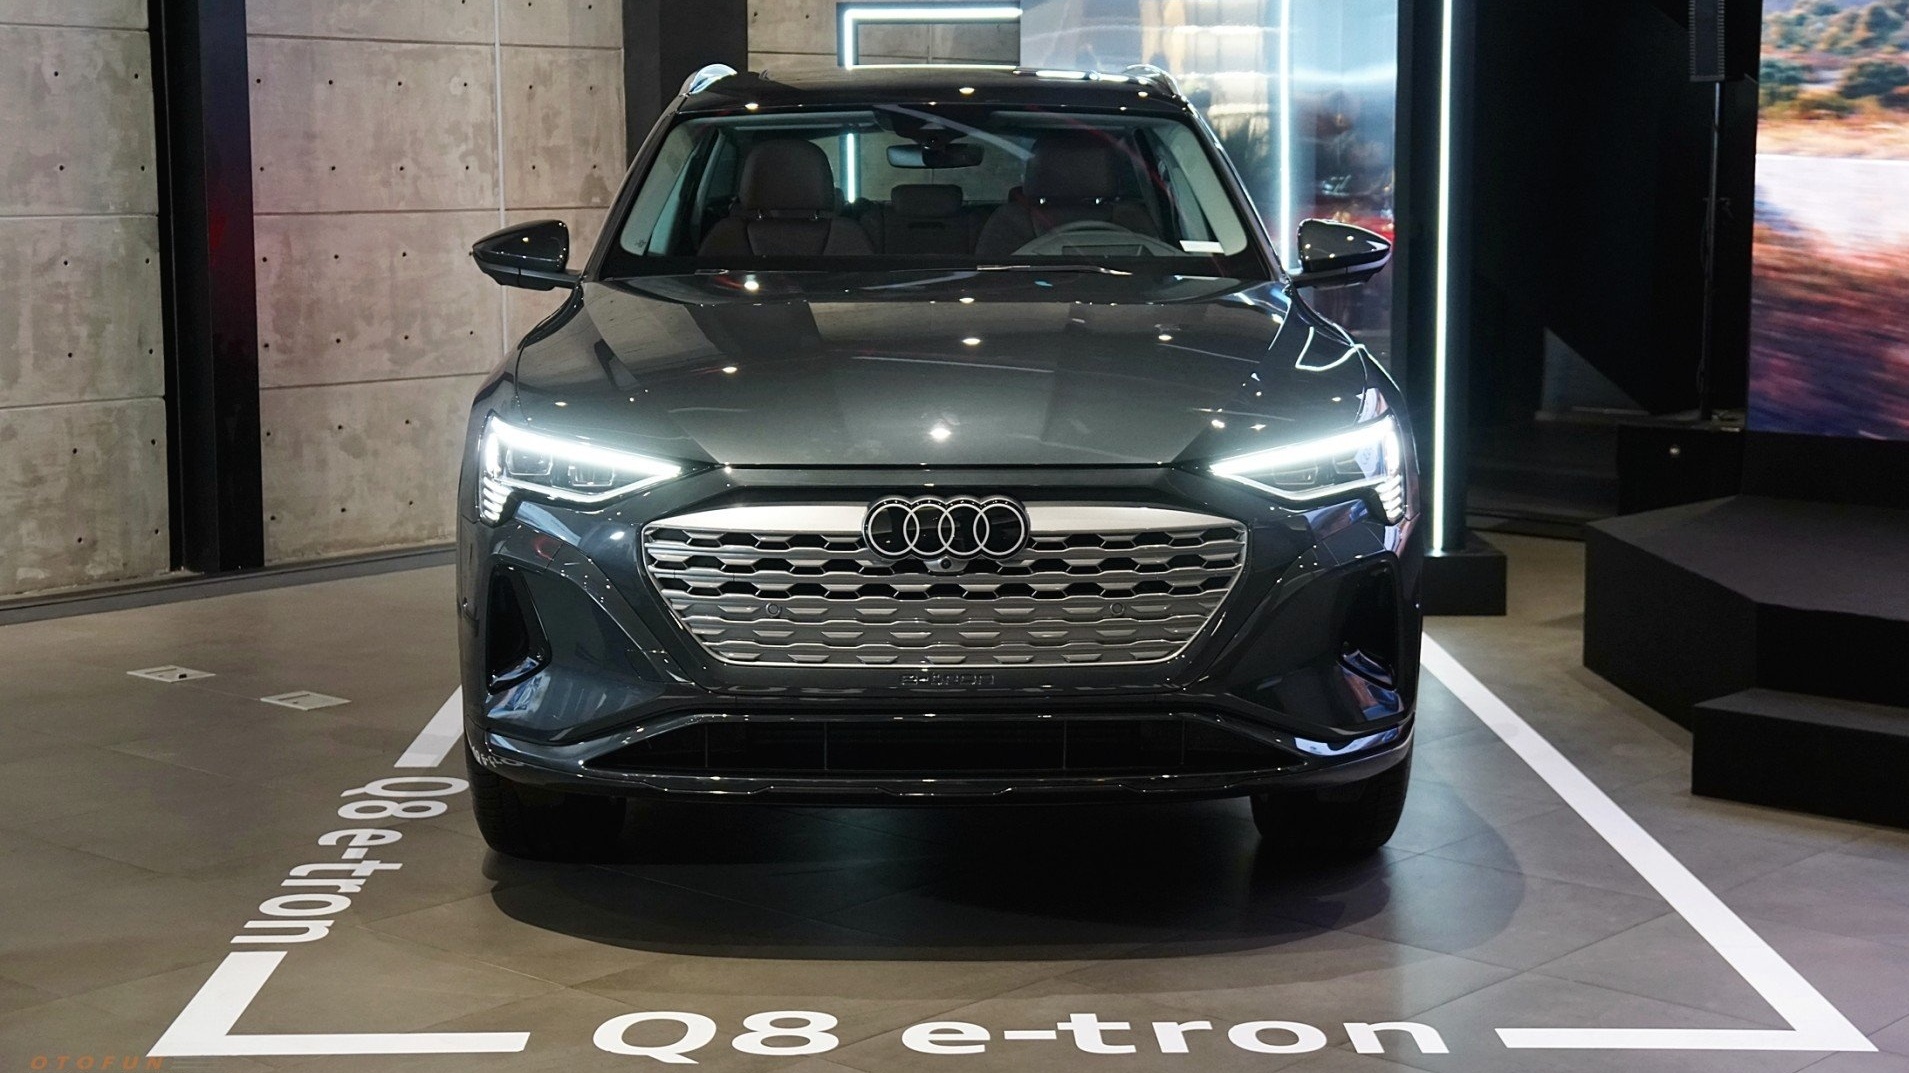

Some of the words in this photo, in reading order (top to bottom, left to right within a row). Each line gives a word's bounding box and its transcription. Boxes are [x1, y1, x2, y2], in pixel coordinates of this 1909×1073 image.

[338, 776, 470, 820] Q8
[230, 828, 403, 944] e-tron
[593, 1011, 840, 1065] Q8
[901, 1013, 1450, 1055] e-tron
